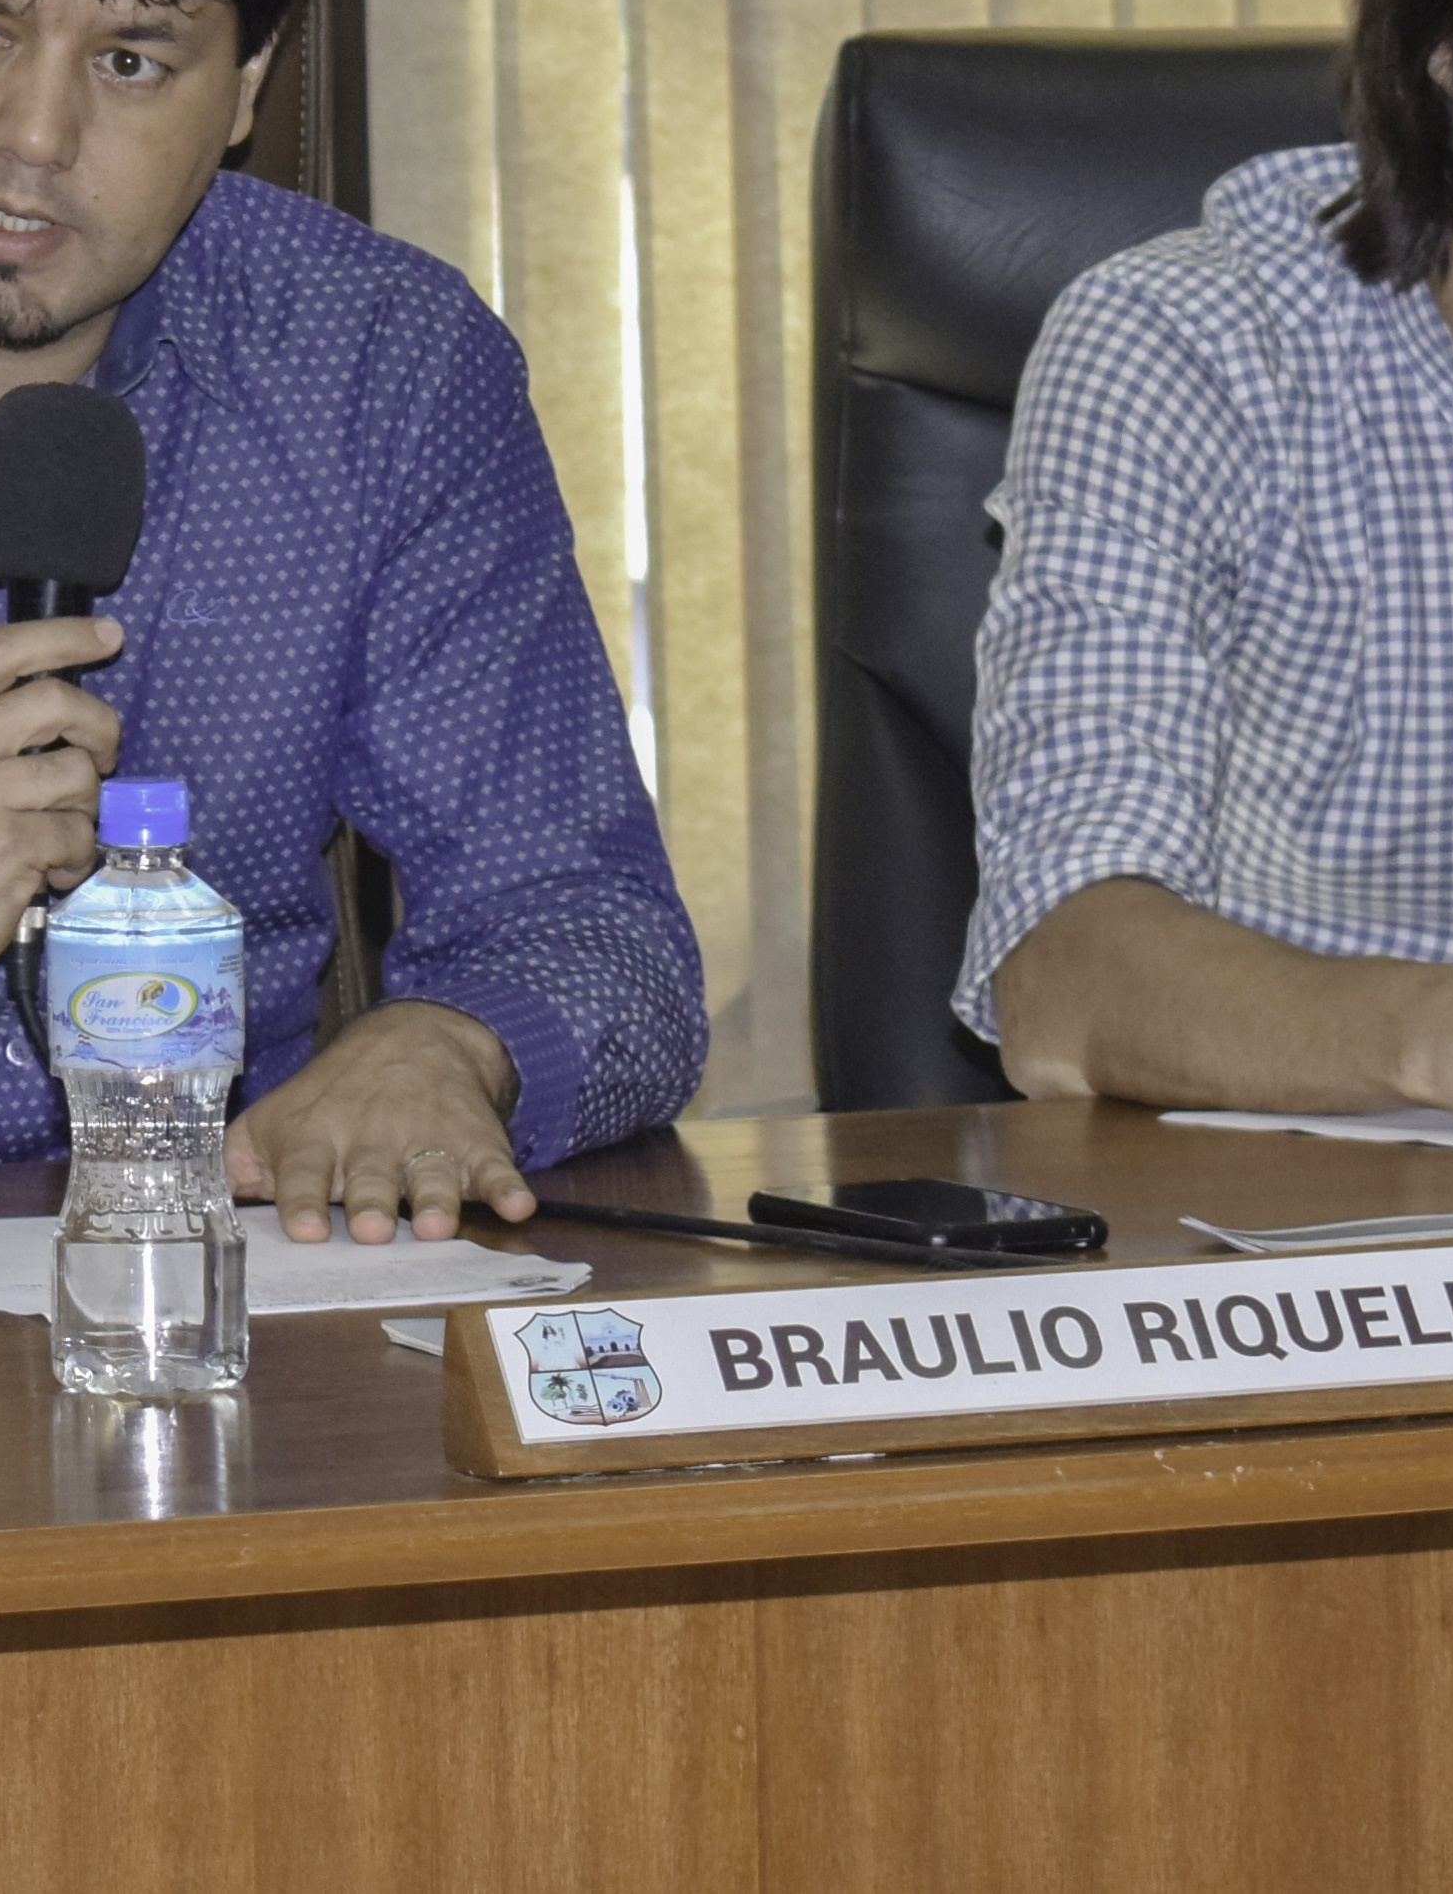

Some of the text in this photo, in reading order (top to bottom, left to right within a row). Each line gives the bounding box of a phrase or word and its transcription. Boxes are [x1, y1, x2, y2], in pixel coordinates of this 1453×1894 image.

[82, 990, 123, 1009] San
[83, 1008, 174, 1027] Francisco
[708, 1305, 1103, 1392] BRAULIO
